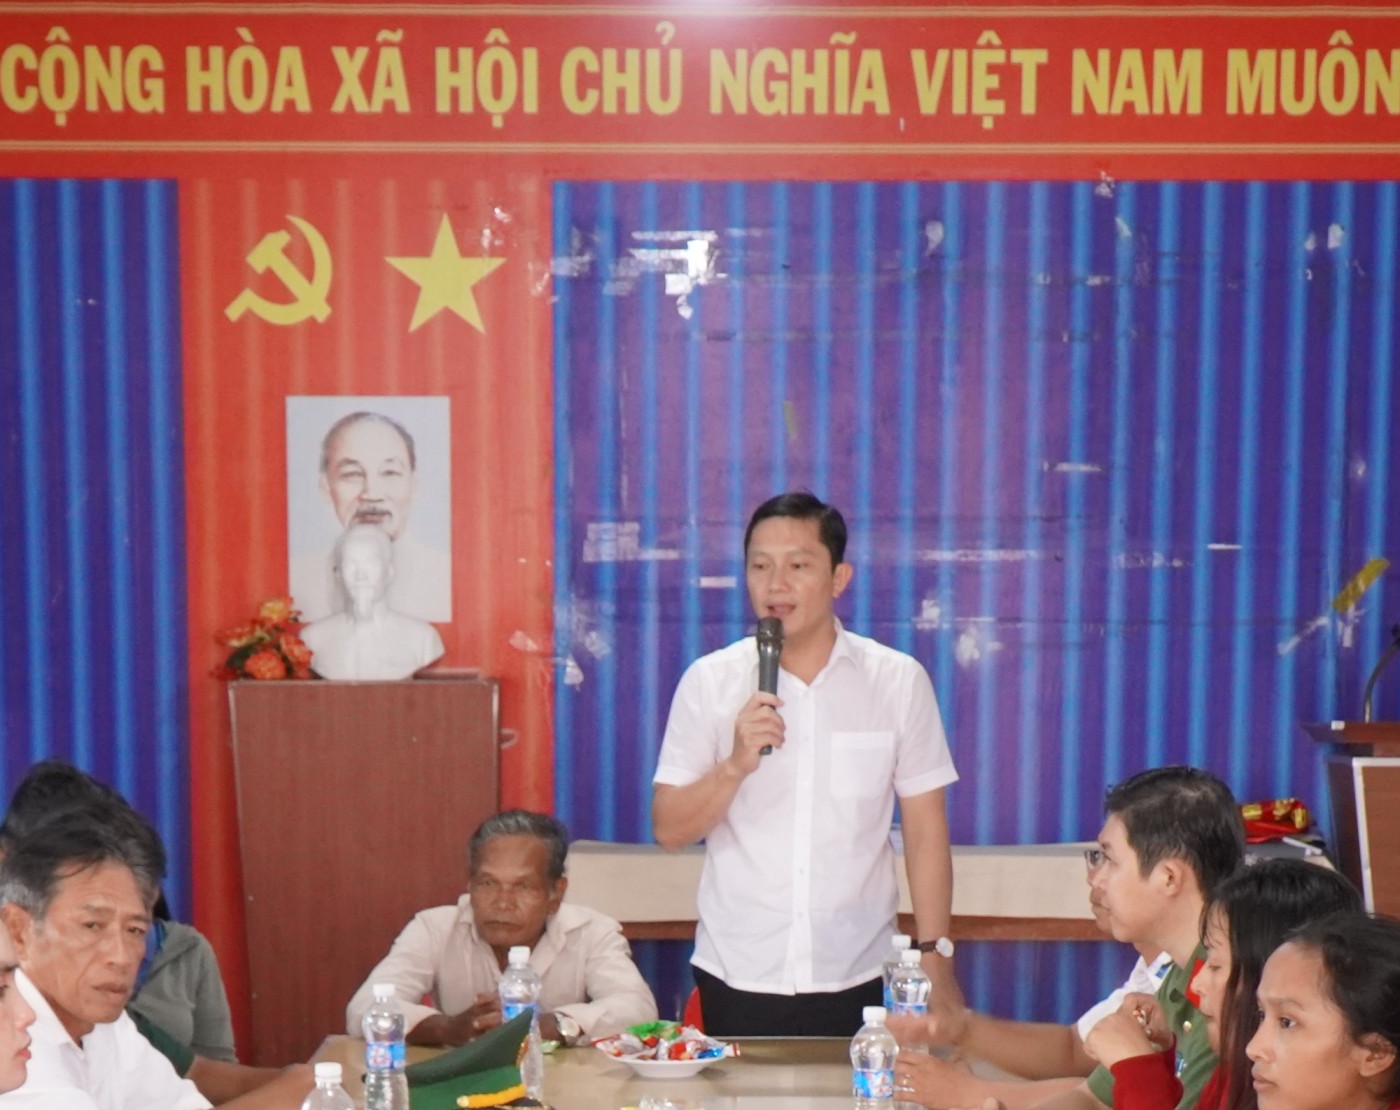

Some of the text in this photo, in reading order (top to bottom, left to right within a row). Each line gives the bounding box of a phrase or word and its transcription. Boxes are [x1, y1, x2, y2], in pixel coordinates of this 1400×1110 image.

[0, 27, 165, 126] CỘNG
[186, 28, 311, 113] HÒA
[331, 29, 411, 113] XÃ
[435, 28, 539, 128] HỘI
[559, 22, 683, 116] CHỦ
[709, 31, 890, 117] NGHĨA
[911, 30, 1049, 129] VIỆT
[1071, 48, 1203, 115] NAM
